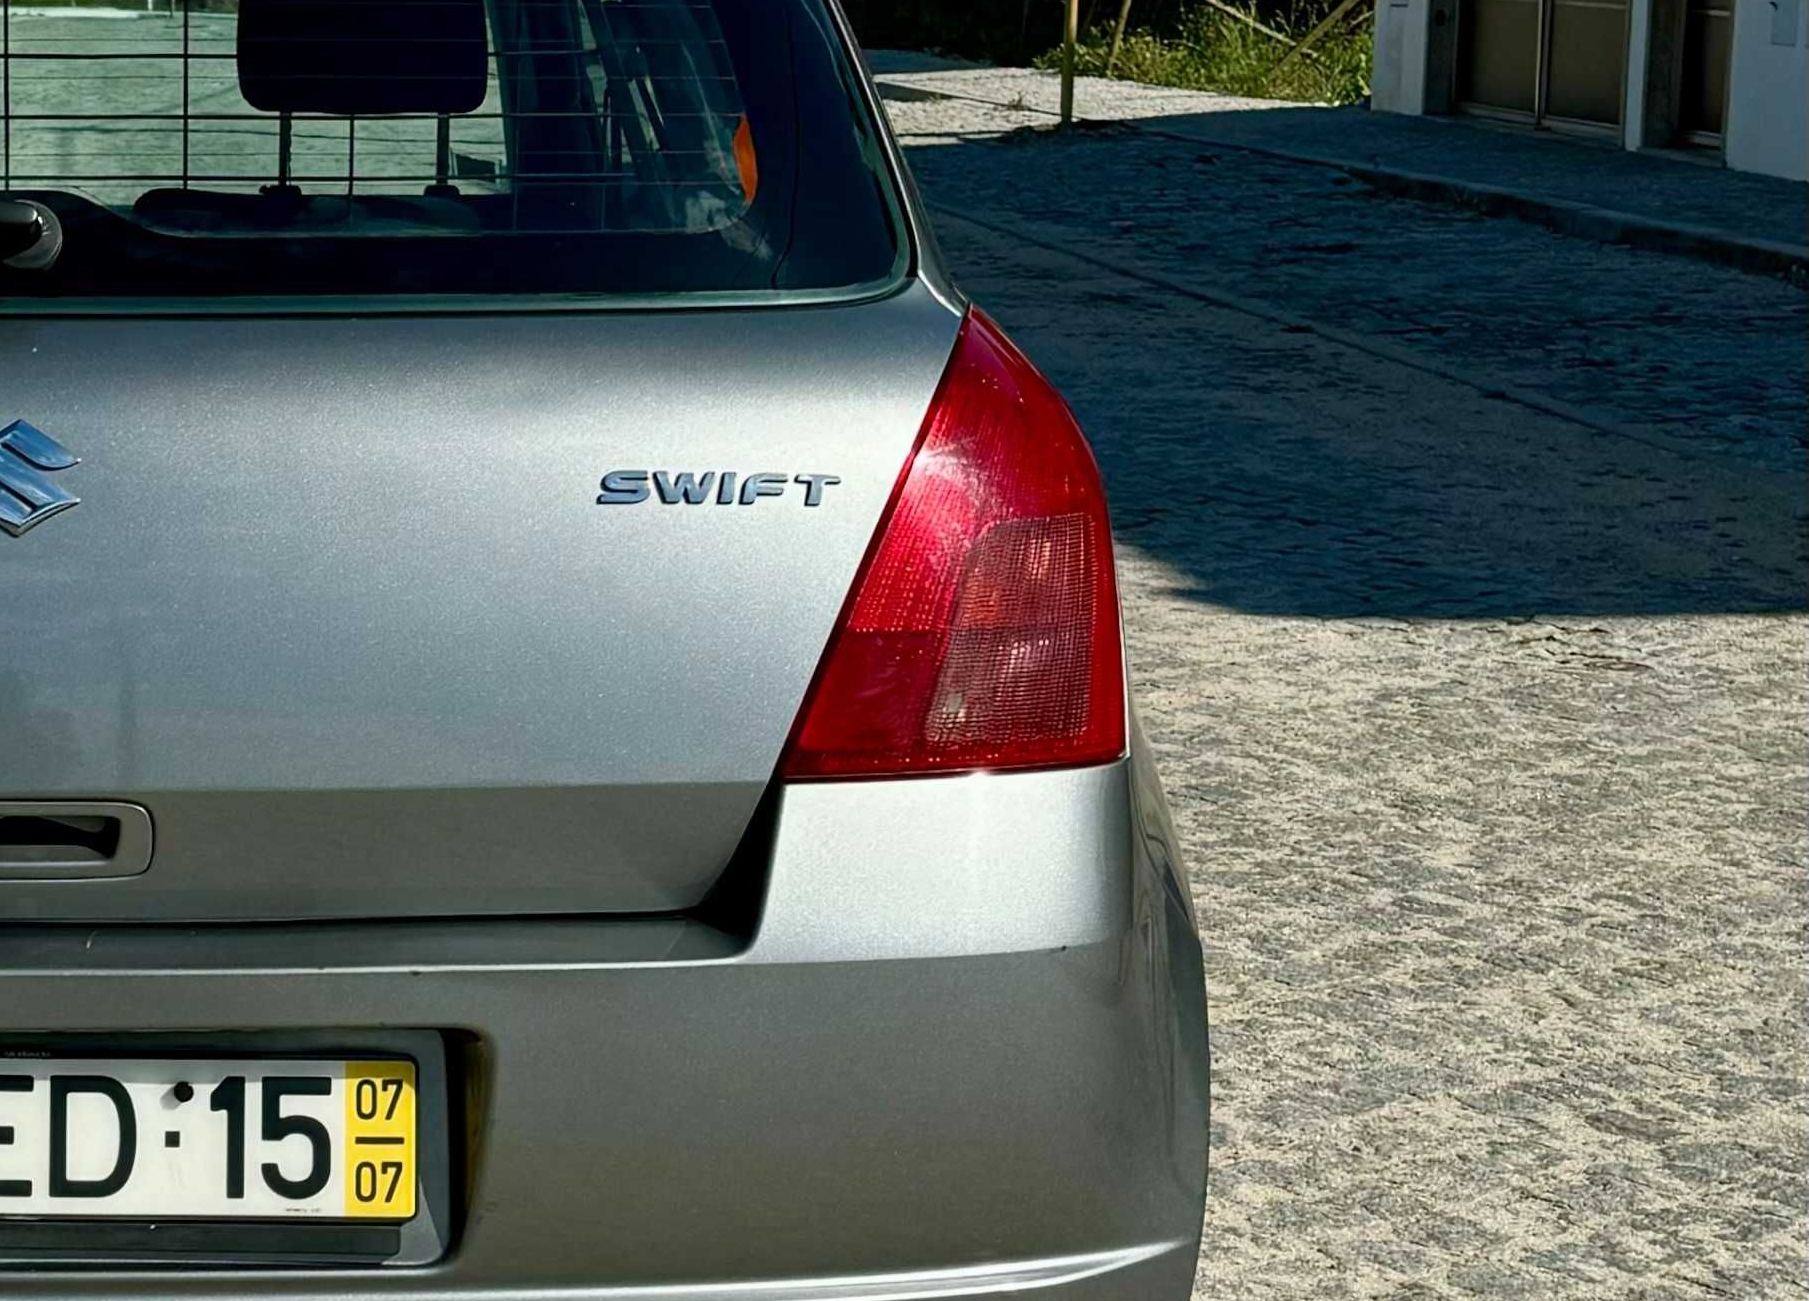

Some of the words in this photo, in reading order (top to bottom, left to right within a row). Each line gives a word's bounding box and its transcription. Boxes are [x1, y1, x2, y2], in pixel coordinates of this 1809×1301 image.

[596, 470, 841, 507] SWIFT
[355, 1078, 404, 1121] 07
[354, 1161, 403, 1203] 07
